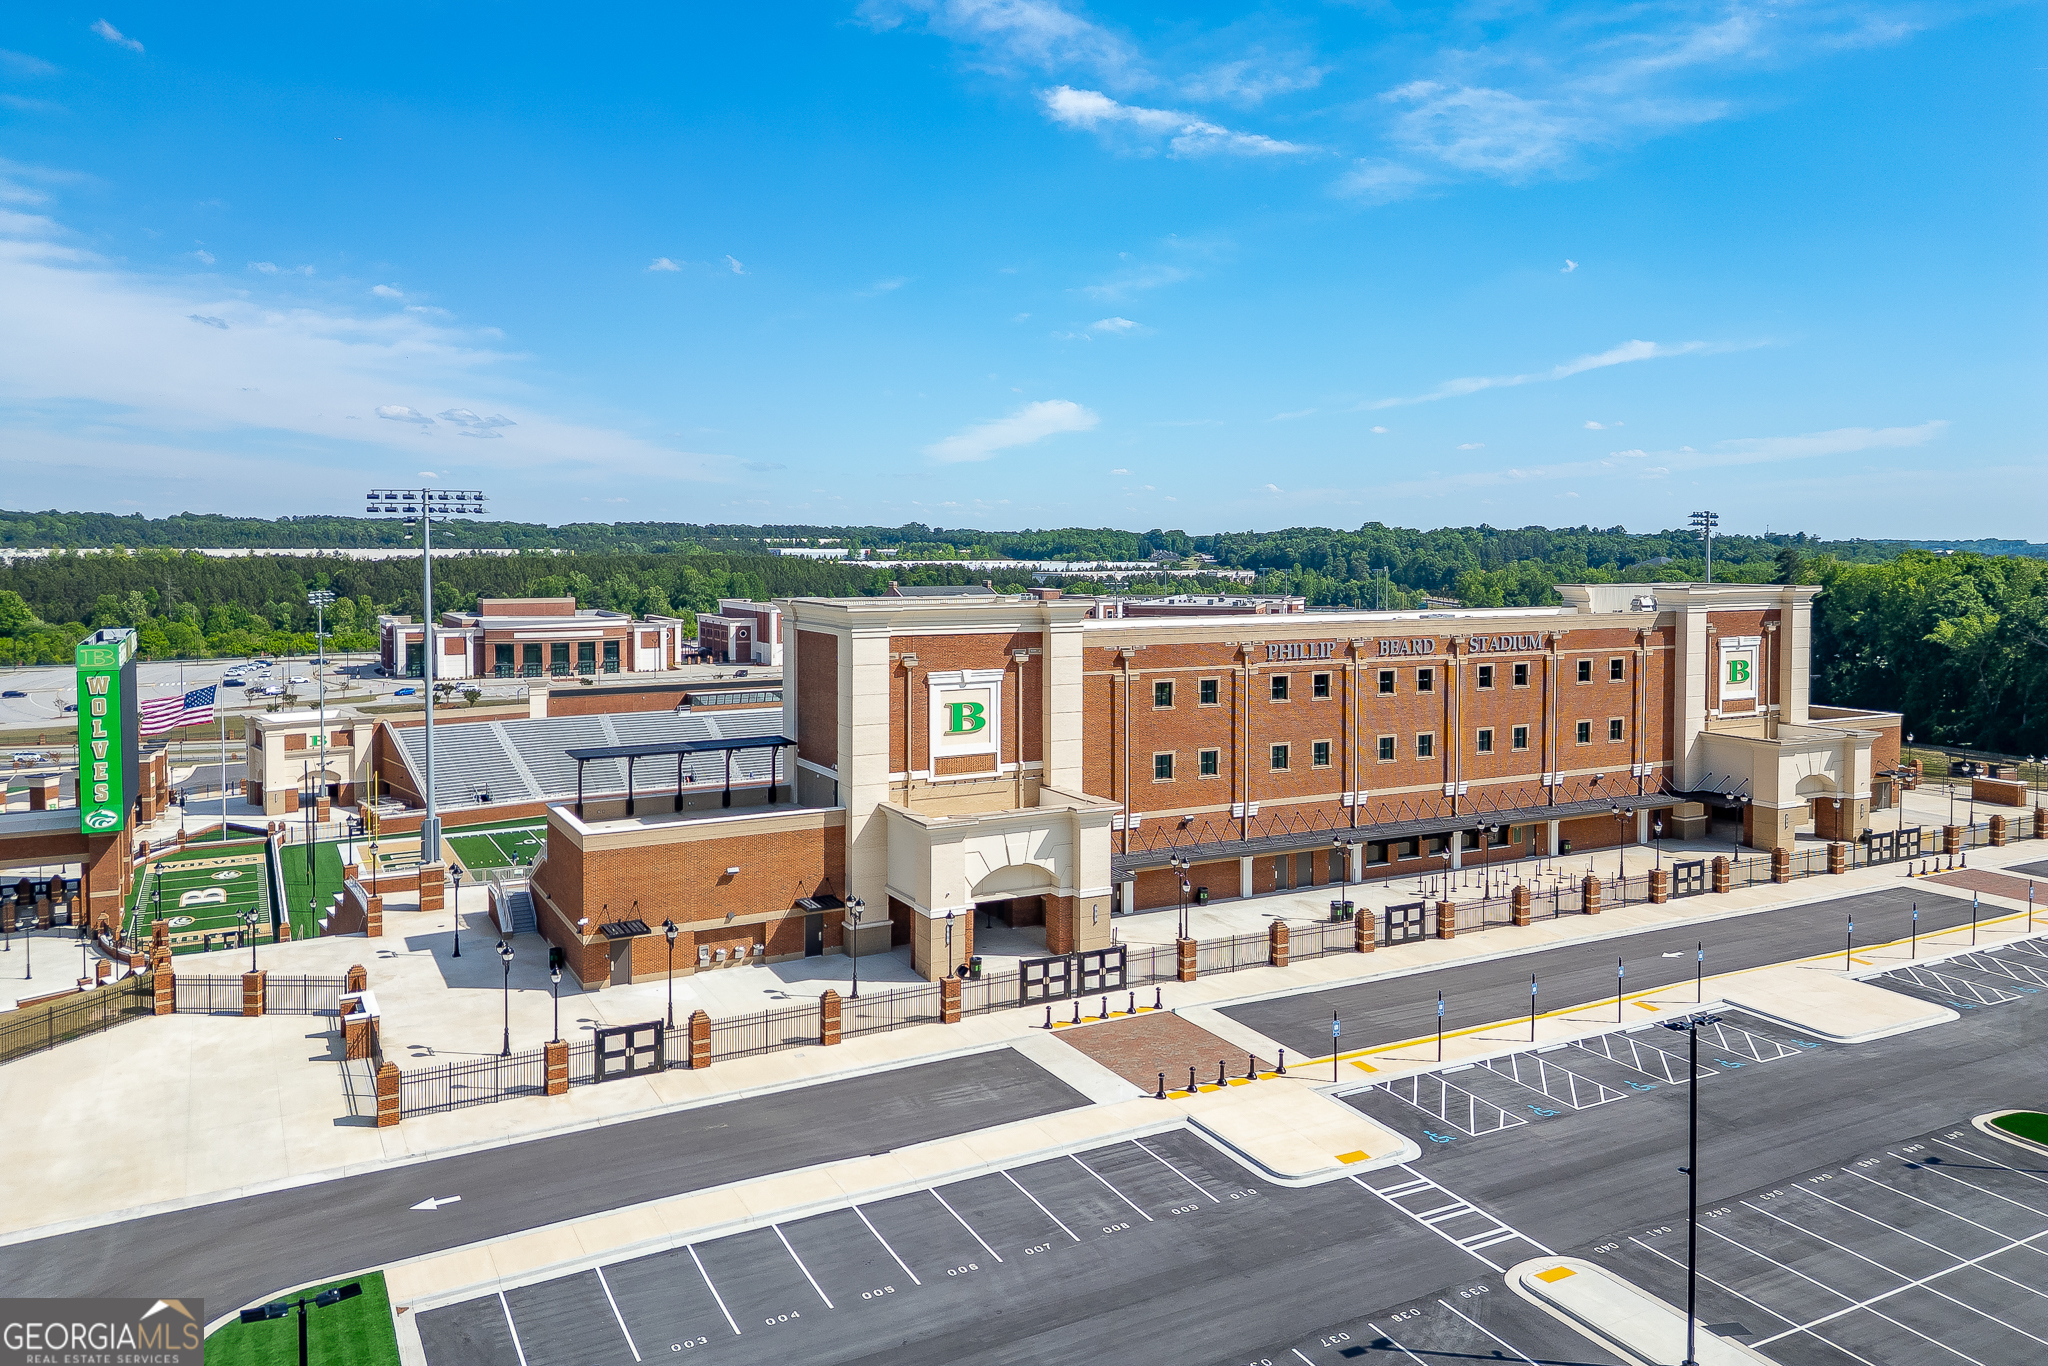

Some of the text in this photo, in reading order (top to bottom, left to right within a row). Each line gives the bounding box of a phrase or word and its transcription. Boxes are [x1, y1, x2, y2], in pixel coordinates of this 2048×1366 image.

[1266, 634, 1543, 661] PHILLIP BEARD STADIUM
[80, 648, 116, 667] B
[1727, 659, 1750, 685] B
[944, 701, 987, 737] B
[86, 675, 111, 803] WOLVES
[1808, 1173, 1833, 1184] 044
[1229, 1188, 1258, 1200] 010
[1759, 1189, 1784, 1200] 043
[1171, 1204, 1199, 1215] 009
[1704, 1207, 1732, 1218] 042
[1102, 1222, 1131, 1234] 008
[1645, 1226, 1672, 1237] 041
[1024, 1242, 1052, 1255] 007
[1593, 1242, 1620, 1254] 040
[947, 1263, 979, 1277] 006
[861, 1285, 896, 1300] 005
[1459, 1285, 1490, 1299] 039
[765, 1310, 800, 1326] 004
[1391, 1308, 1421, 1323] 038
[670, 1336, 709, 1352] 003
[1320, 1332, 1351, 1348] 037
